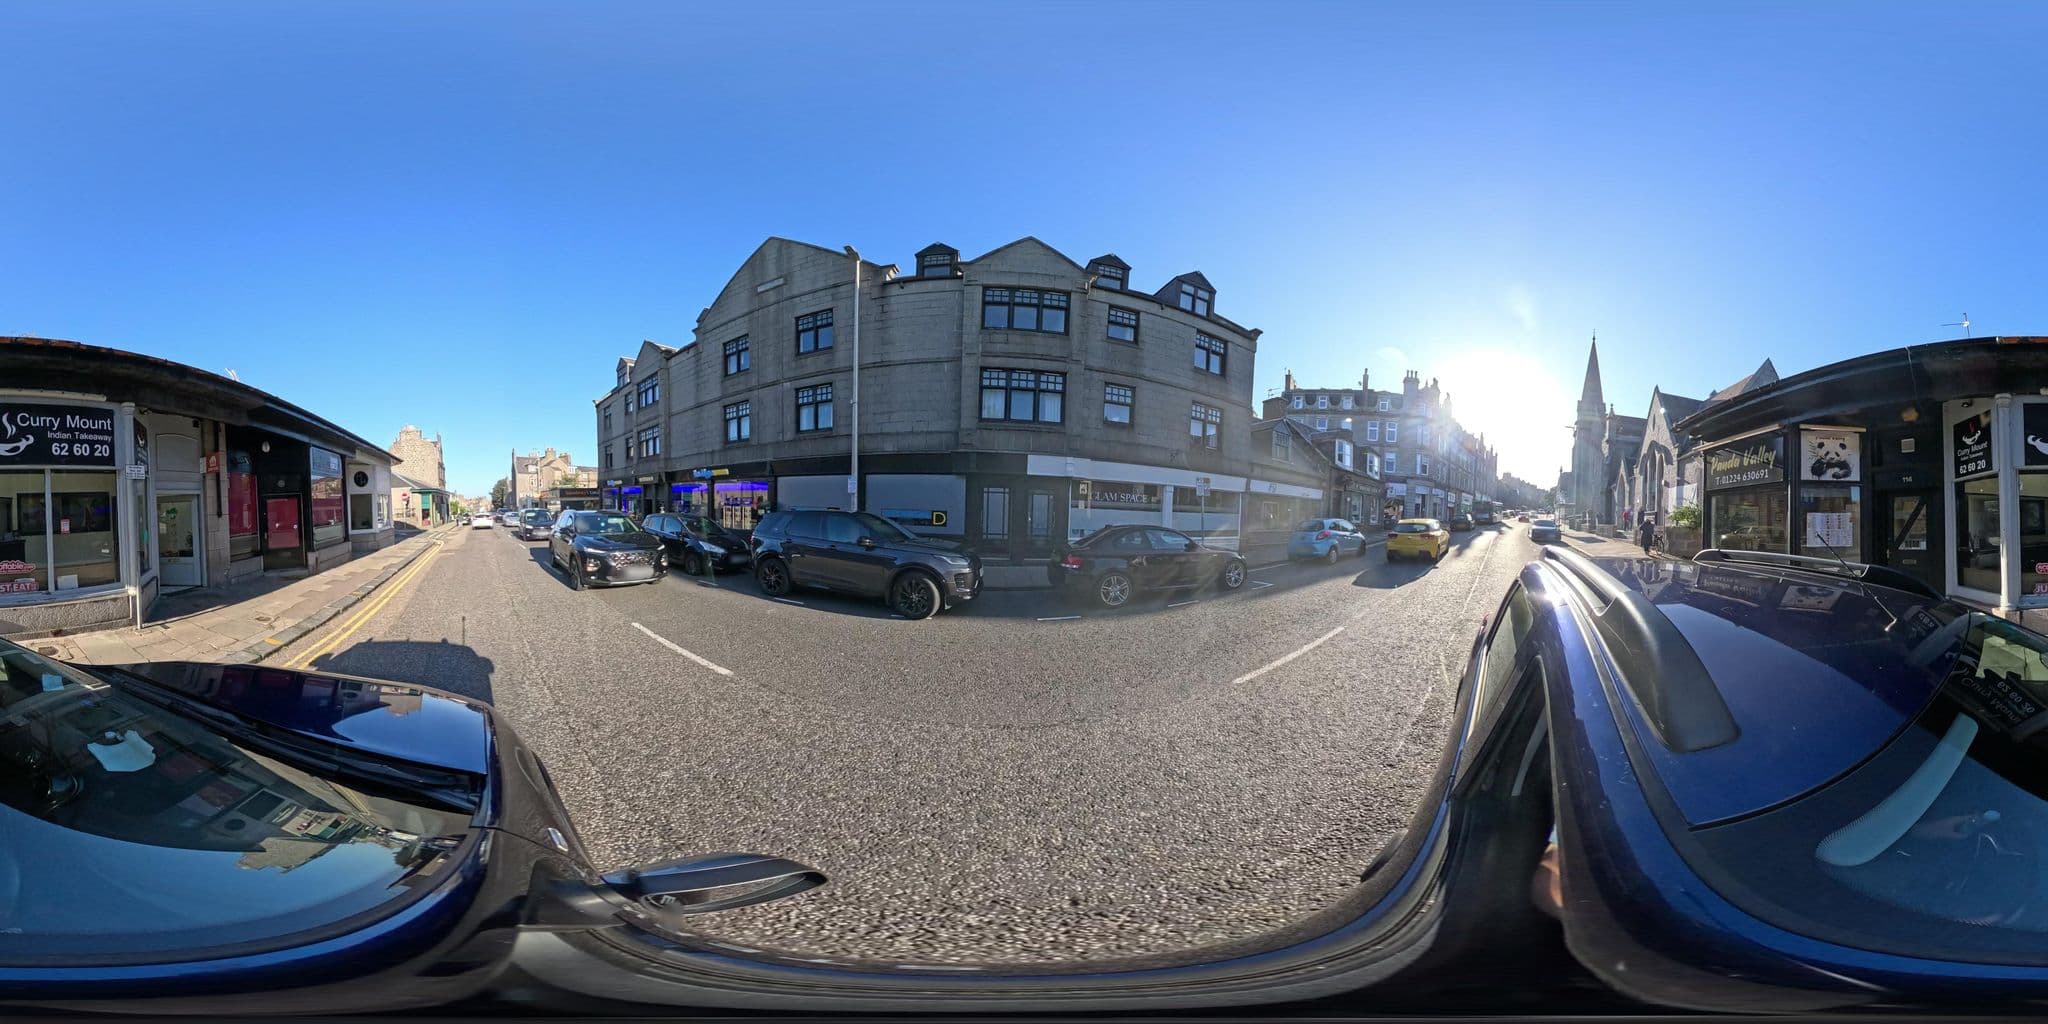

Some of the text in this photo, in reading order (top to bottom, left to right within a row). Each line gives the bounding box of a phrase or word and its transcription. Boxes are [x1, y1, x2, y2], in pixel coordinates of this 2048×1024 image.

[17, 412, 112, 431] Curry Mount
[47, 430, 112, 443] Indian Takeaway
[51, 442, 110, 457] 62 60 20
[1957, 448, 1970, 457] Curry
[1711, 444, 1776, 476] Panda Valley
[1959, 459, 1986, 474] 62 60 20
[1742, 469, 1769, 481] 630691
[1120, 492, 1149, 504] SPACE
[13, 582, 31, 592] EAT
